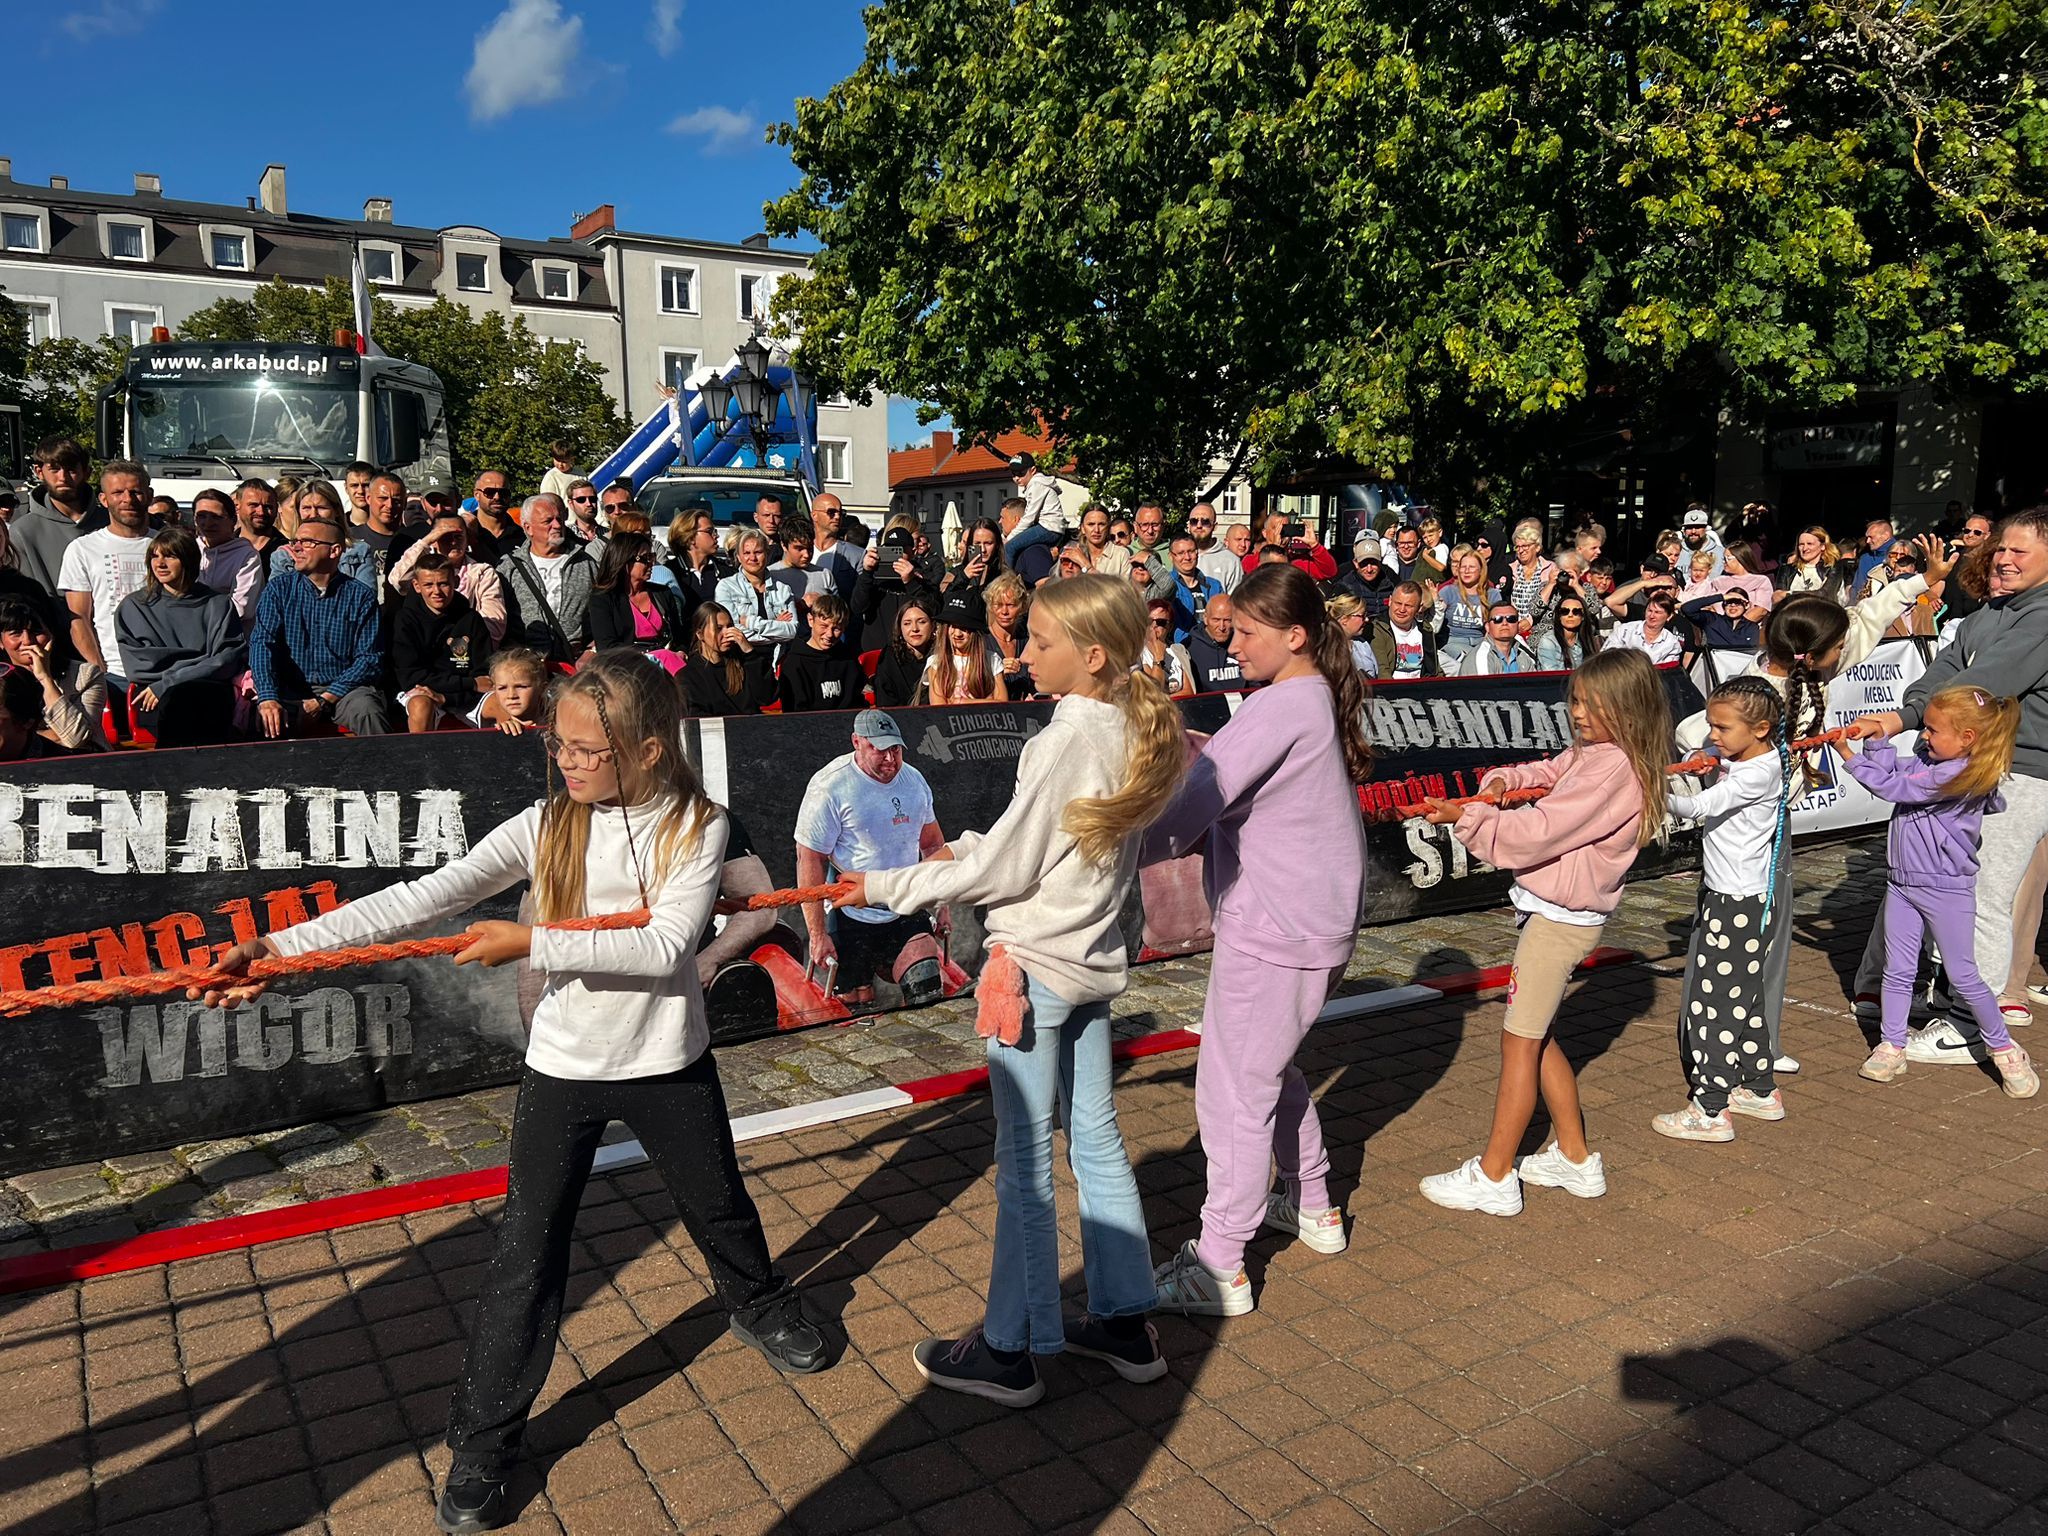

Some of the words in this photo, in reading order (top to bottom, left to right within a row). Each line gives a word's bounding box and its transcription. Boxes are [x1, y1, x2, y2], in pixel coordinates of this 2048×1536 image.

[1845, 664, 1903, 682] PRODUCENT
[1864, 686, 1894, 704] MEBLI
[948, 712, 1018, 735] FUNDACJA
[956, 738, 1023, 761] STRONGMAN
